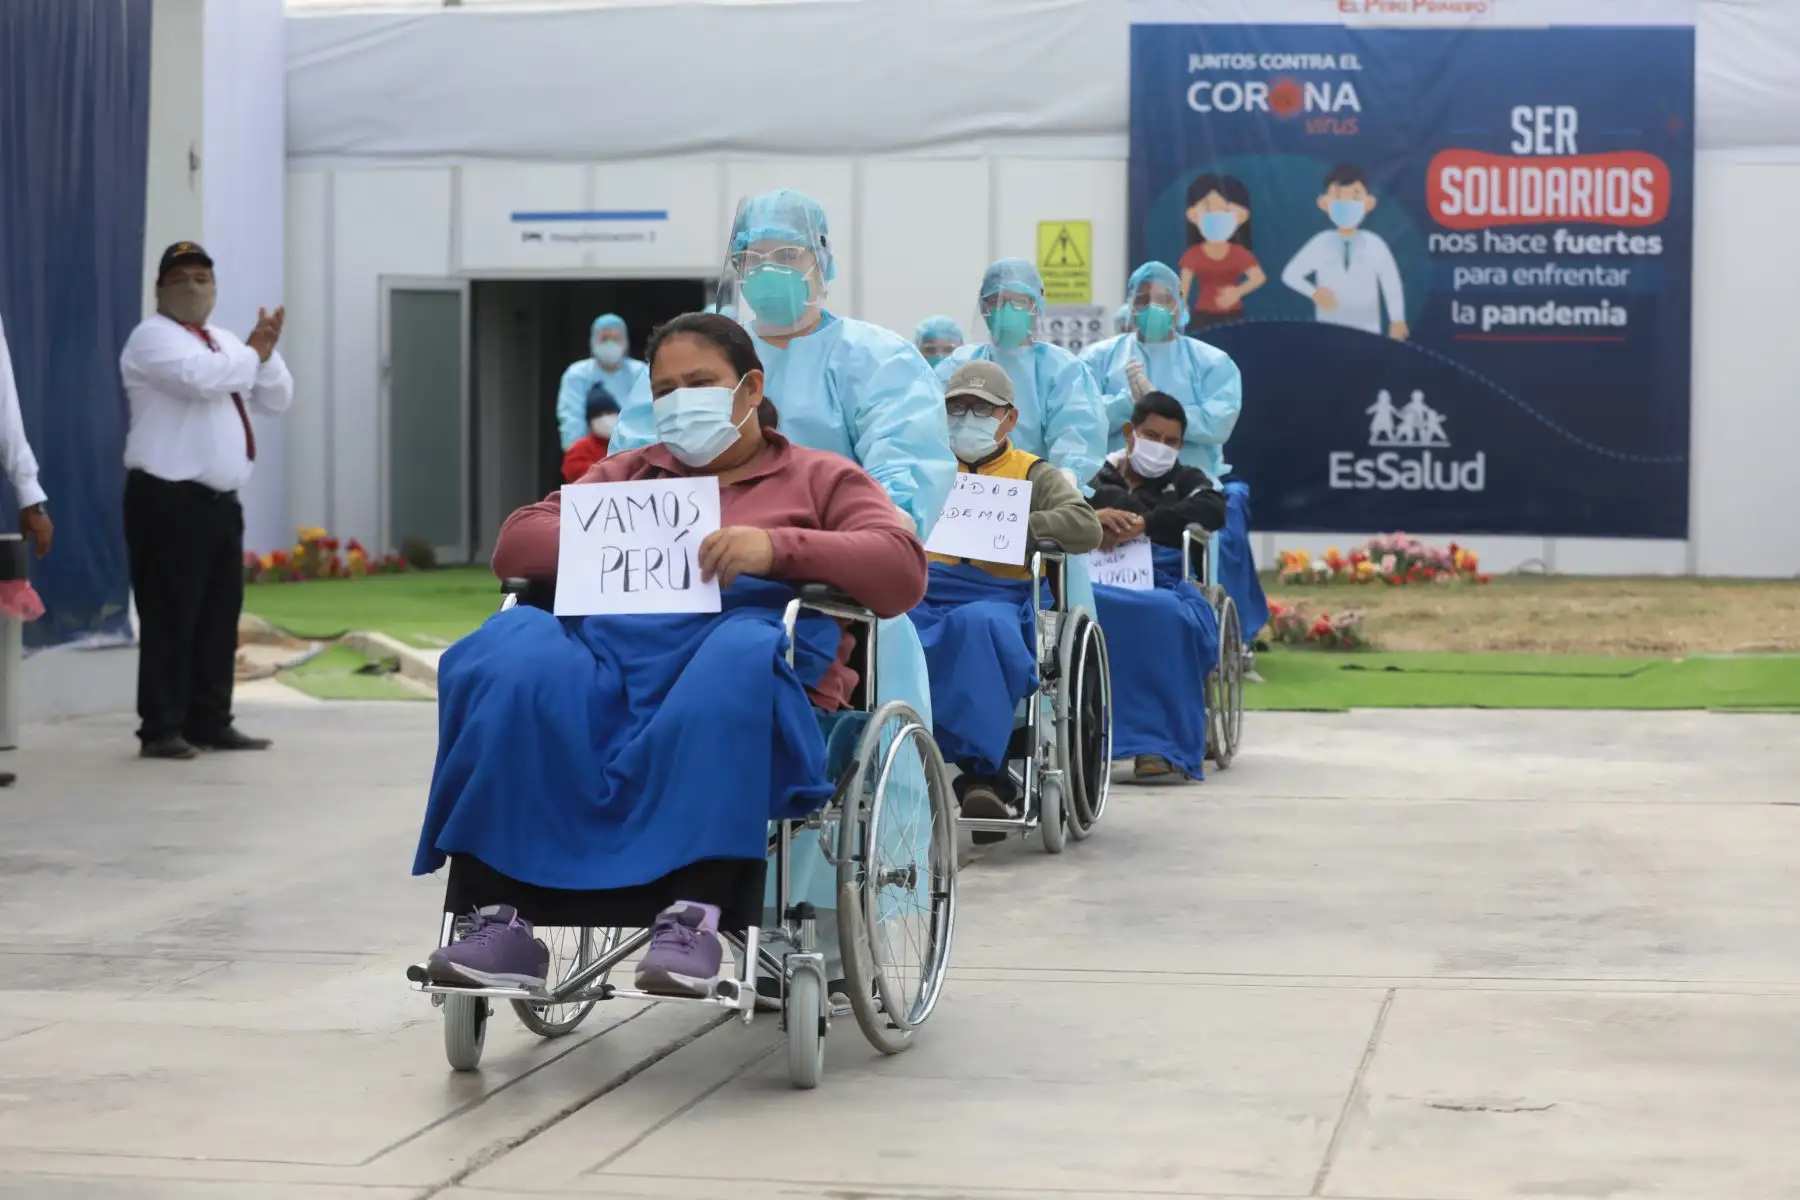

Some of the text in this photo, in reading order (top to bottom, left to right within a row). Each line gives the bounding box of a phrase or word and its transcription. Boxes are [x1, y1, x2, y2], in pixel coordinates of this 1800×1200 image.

[1187, 53, 1364, 74] JUNTOS CONTRA EL
[1305, 115, 1359, 136] virus
[1510, 104, 1579, 155] SER
[1439, 165, 1655, 218] SOLIDARIOS
[1427, 228, 1663, 256] nos hace fuertes
[1453, 261, 1632, 292] para enfrentar
[1450, 298, 1628, 332] la pandemia
[1328, 449, 1486, 492] EsSalud
[571, 490, 701, 534] VAMOS
[600, 528, 691, 595] PERÚ
